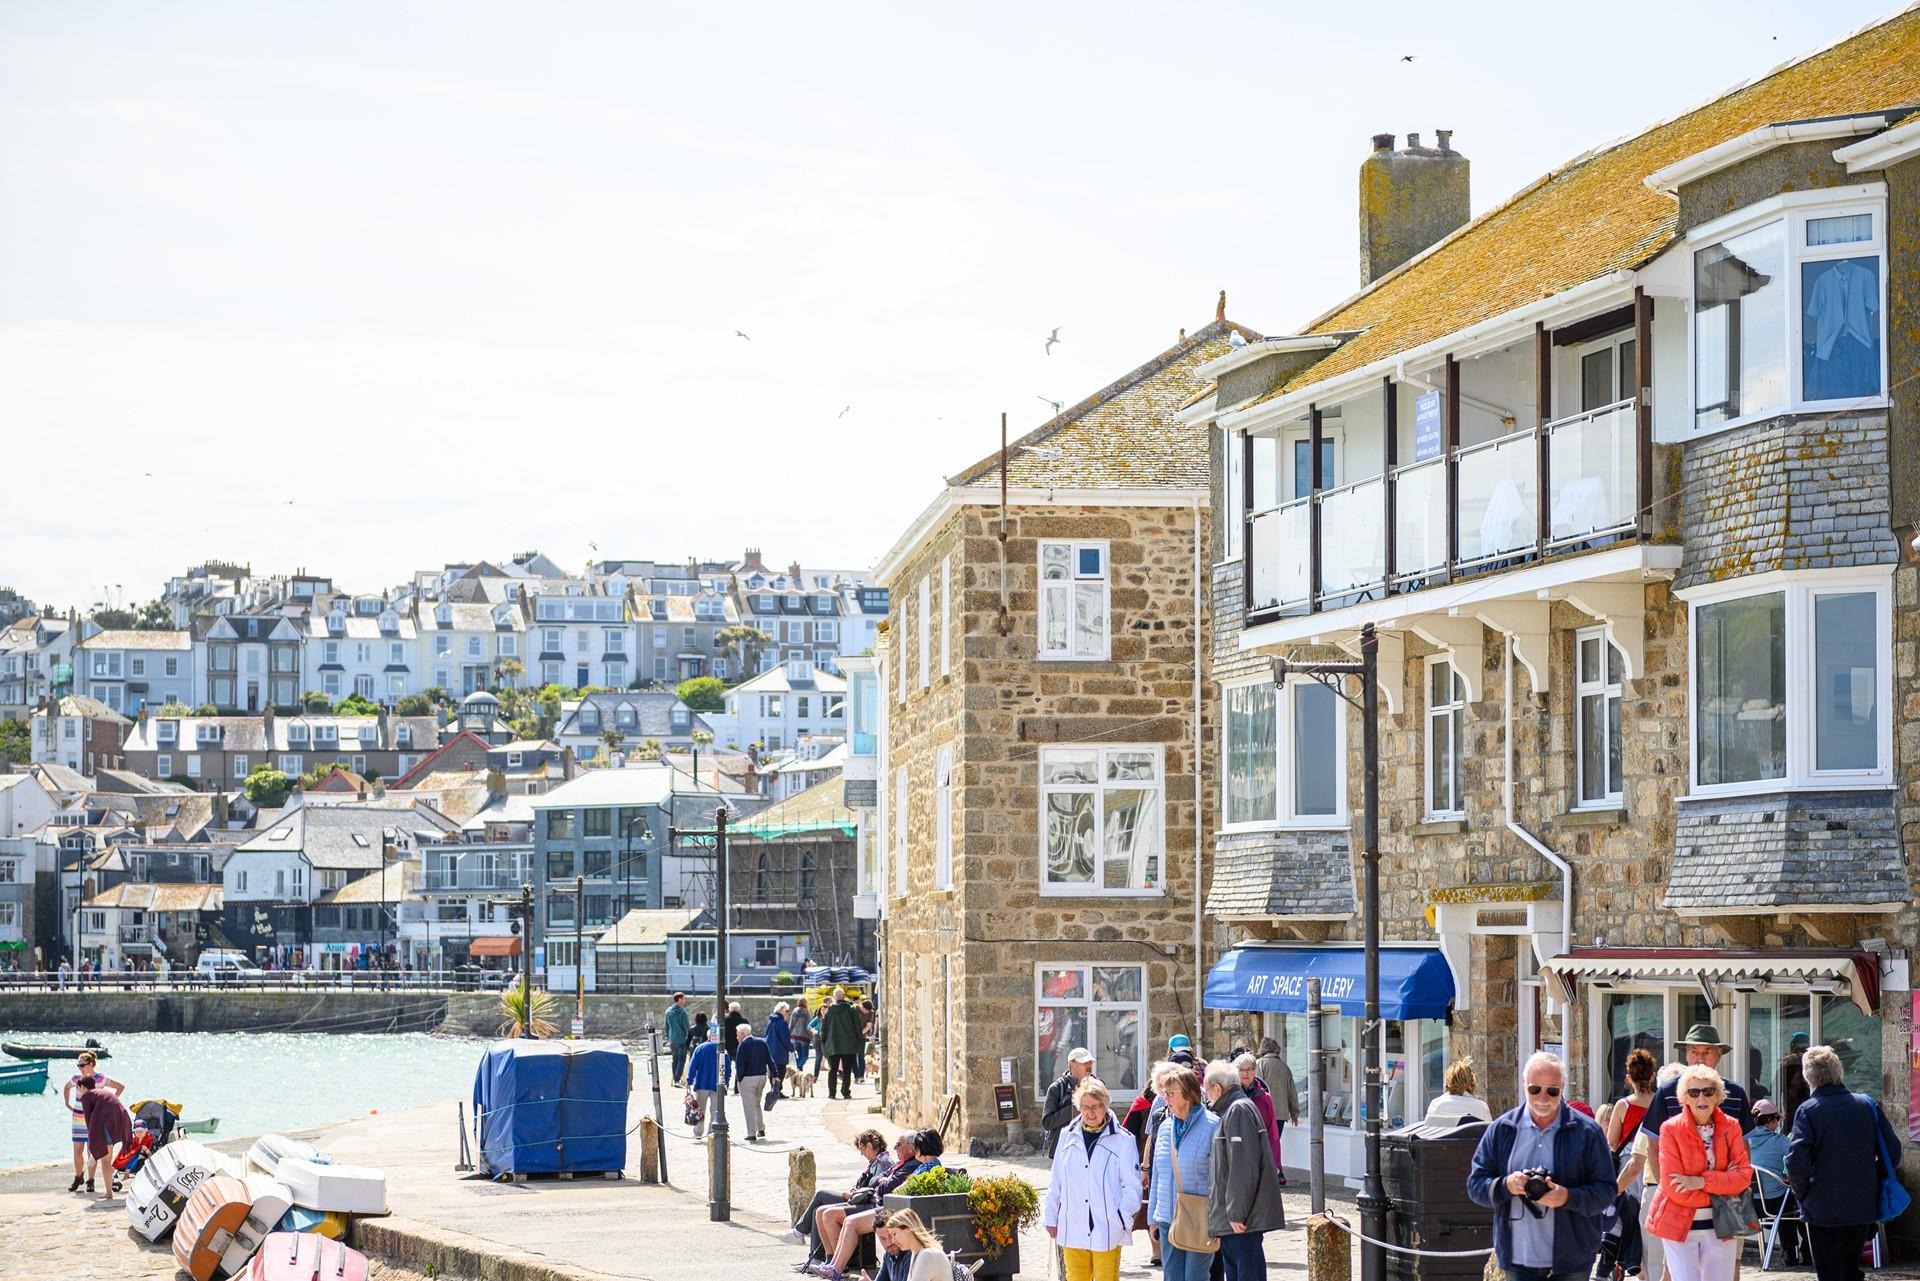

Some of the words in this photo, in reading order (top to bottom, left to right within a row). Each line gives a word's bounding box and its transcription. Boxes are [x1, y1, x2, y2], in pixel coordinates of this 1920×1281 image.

[1246, 975, 1268, 994] ART
[1271, 975, 1303, 996] SPACE
[1318, 976, 1355, 998] LLERY
